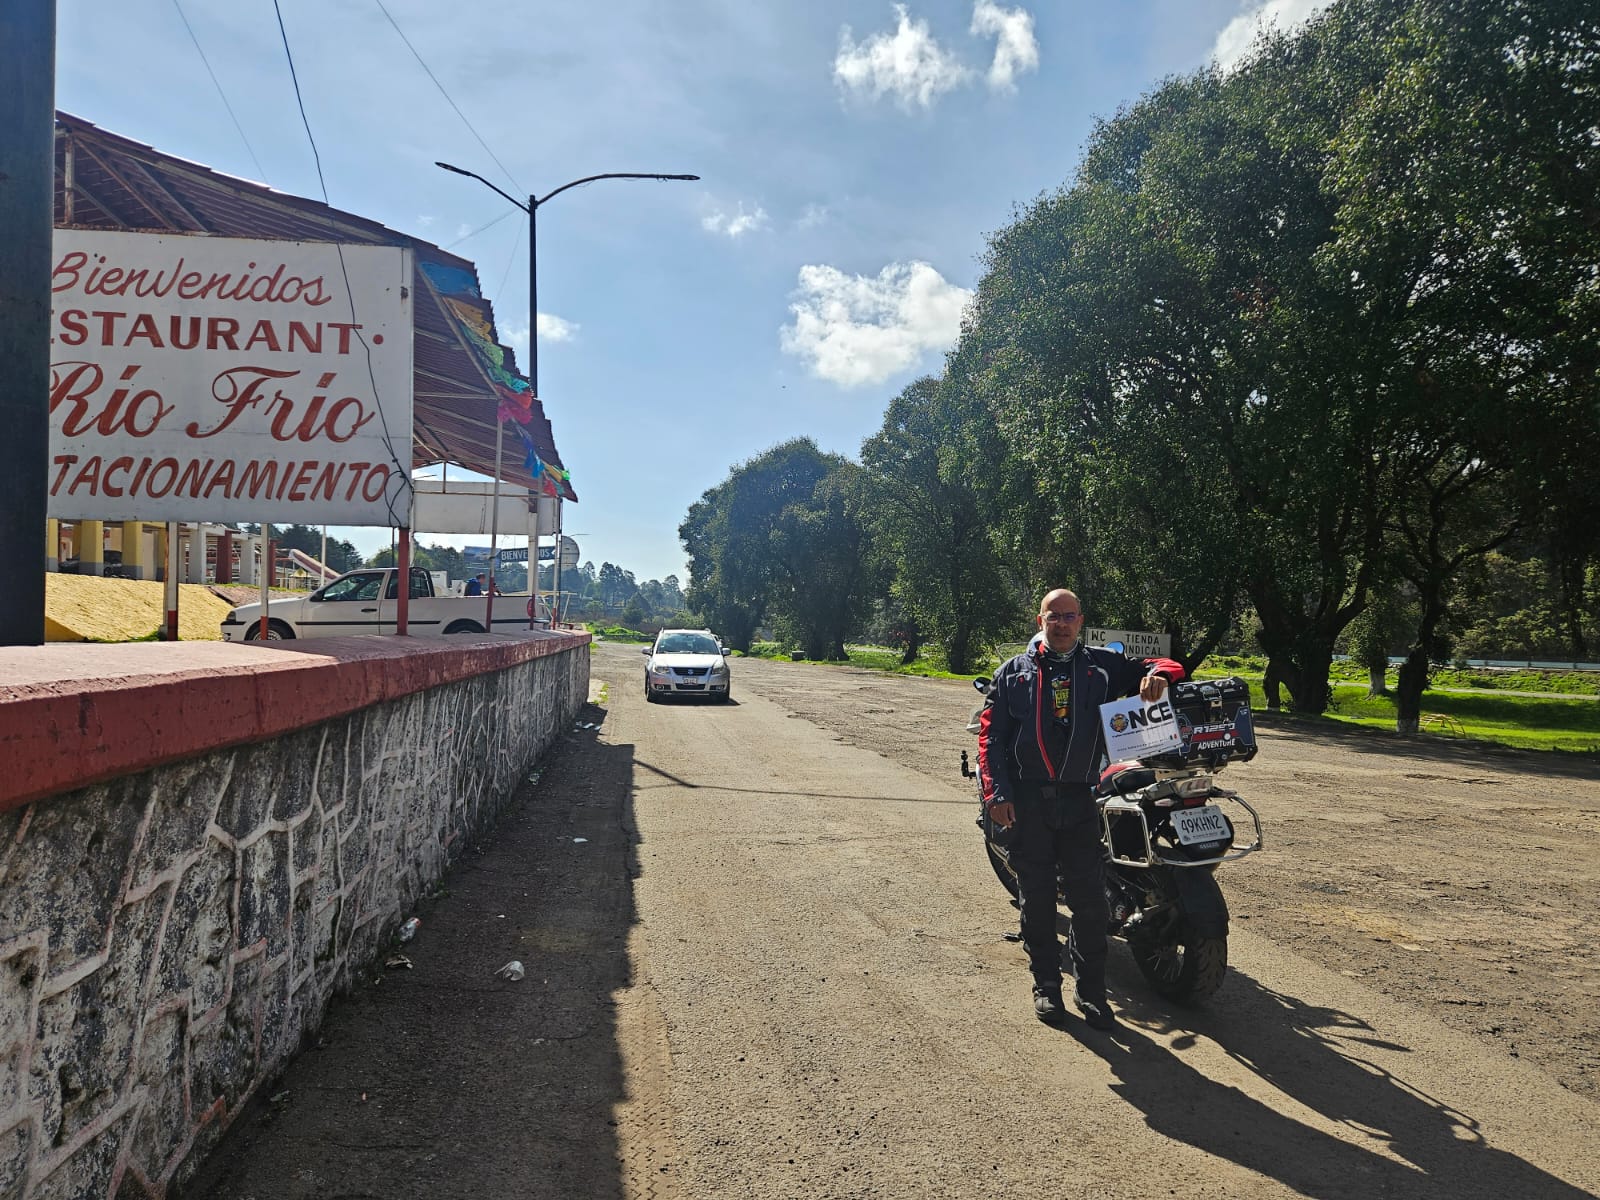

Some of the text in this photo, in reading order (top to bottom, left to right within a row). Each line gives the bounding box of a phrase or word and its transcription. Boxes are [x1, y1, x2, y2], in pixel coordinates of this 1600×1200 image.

[51, 251, 332, 306] Bienvenidos
[50, 308, 363, 354] STAURANT
[49, 454, 390, 502] TACIONAMIENTO
[501, 548, 550, 561] BIENVEOS
[1126, 633, 1160, 645] TIENDA
[1197, 738, 1236, 751] ADVENTURE
[1181, 815, 1223, 834] 49KHN2
